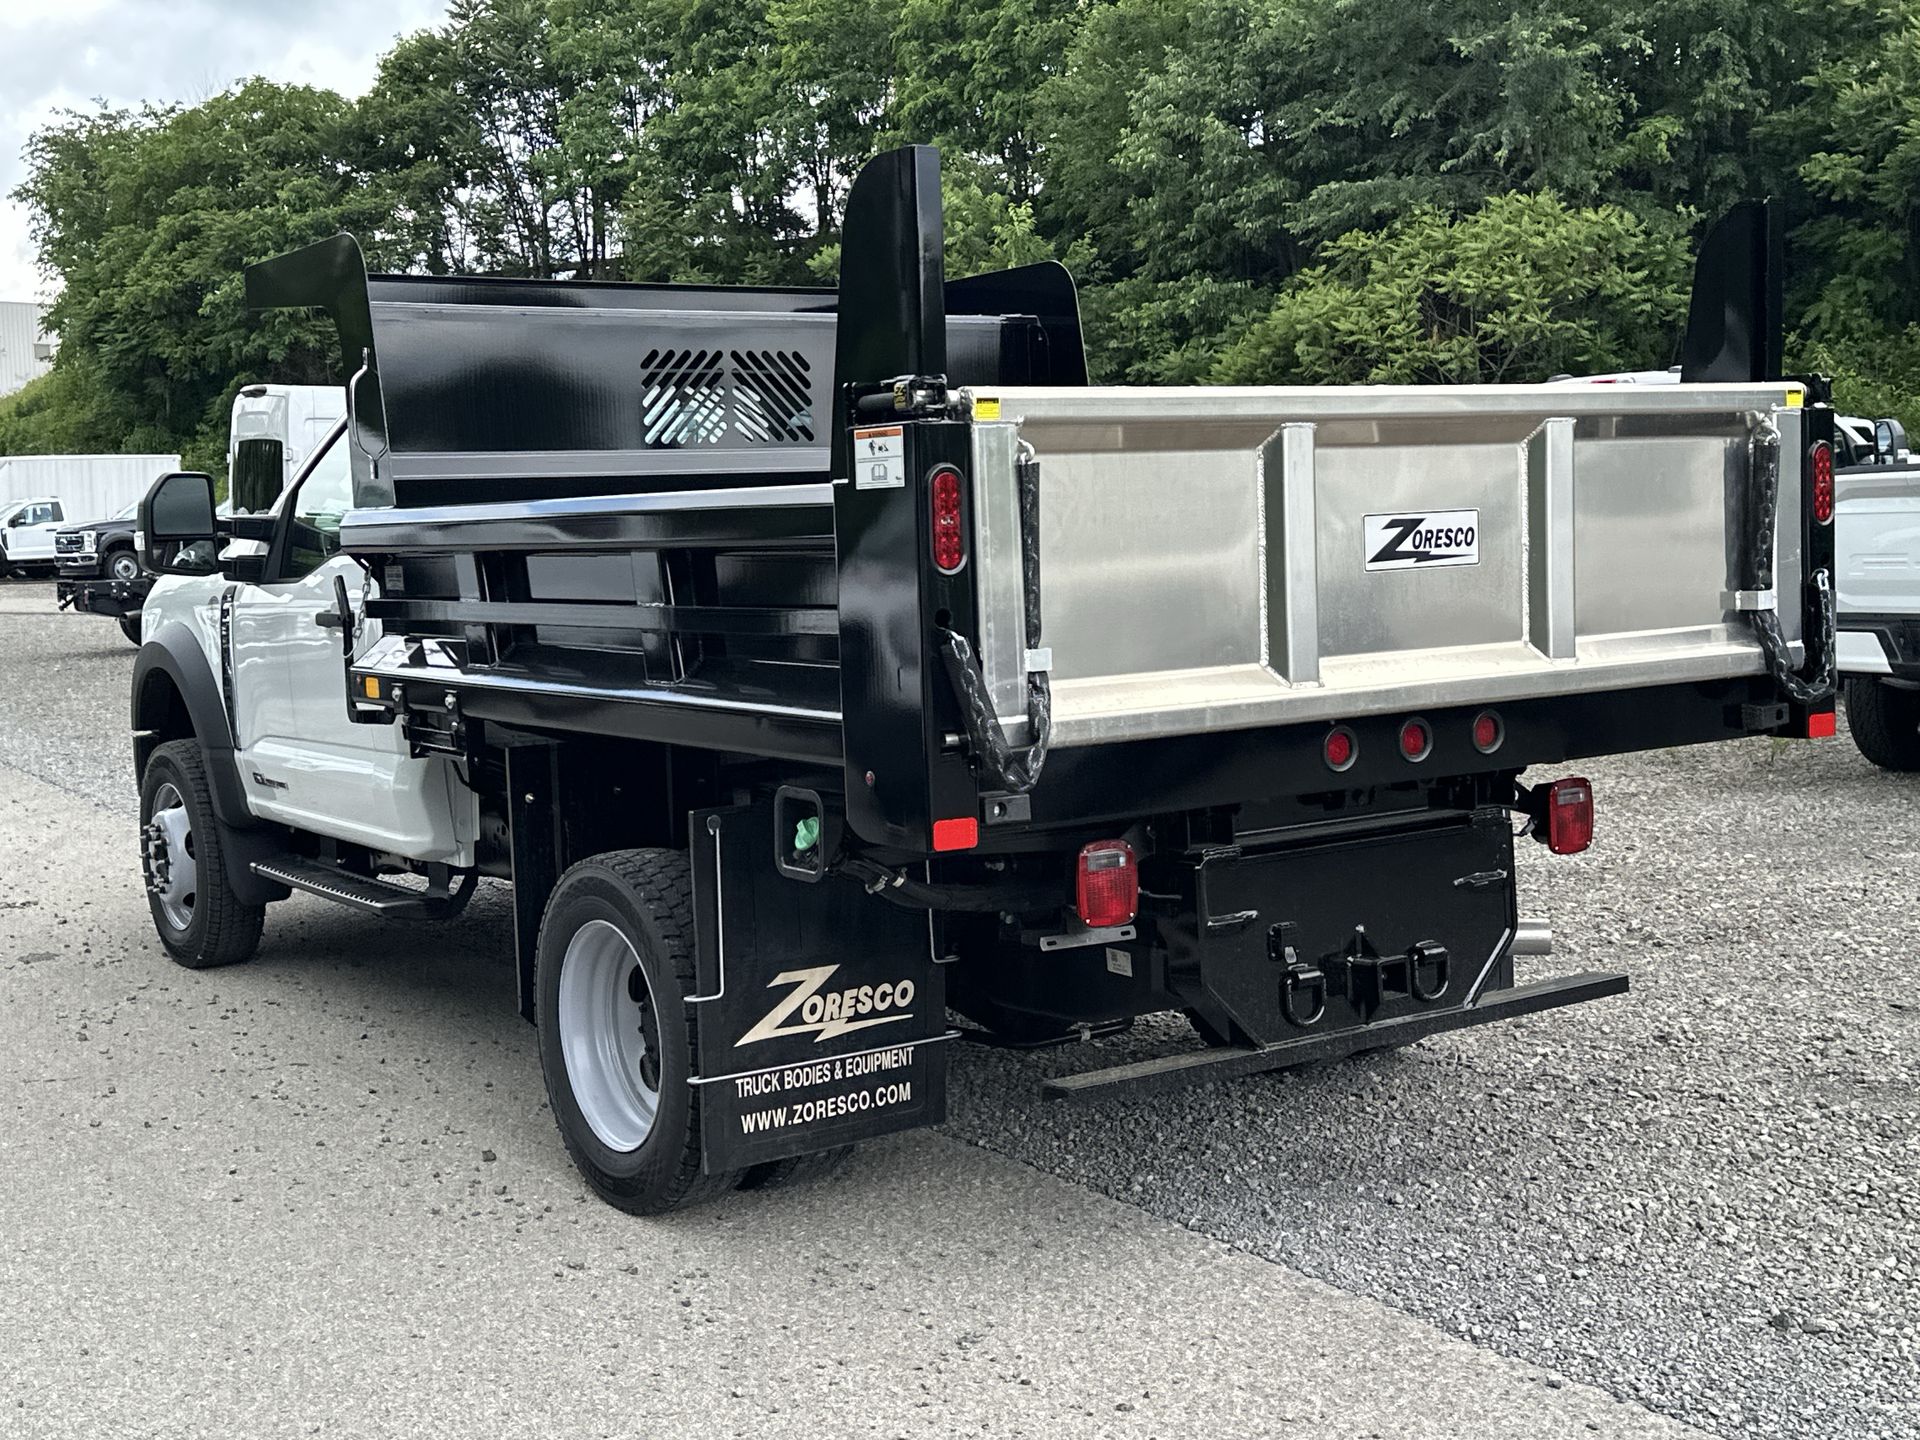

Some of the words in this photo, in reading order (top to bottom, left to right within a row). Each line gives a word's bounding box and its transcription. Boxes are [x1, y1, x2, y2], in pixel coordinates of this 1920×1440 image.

[1367, 518, 1475, 563] ZORESCO
[734, 964, 915, 1047] ZORESCO
[735, 1073, 781, 1098] TRUCK
[784, 1064, 831, 1090] BODIES
[834, 1062, 843, 1079] &
[845, 1047, 914, 1078] EQUIPMENT
[741, 1082, 912, 1134] WWW.ZORESCO.COM
